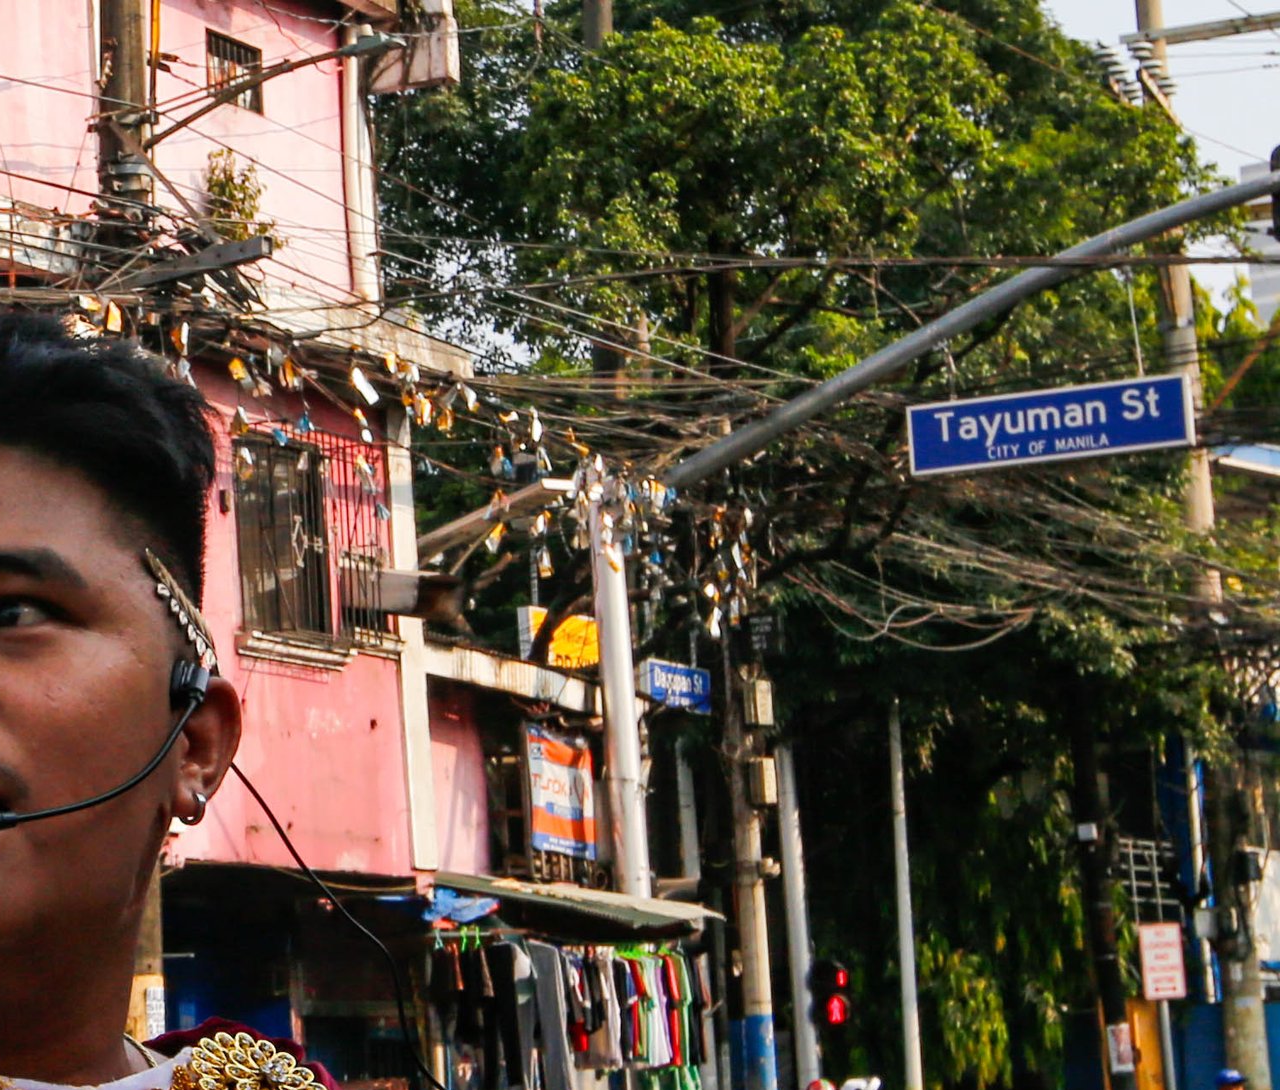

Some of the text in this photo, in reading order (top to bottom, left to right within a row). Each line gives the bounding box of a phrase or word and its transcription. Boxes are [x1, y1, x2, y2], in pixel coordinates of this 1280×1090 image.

[934, 387, 1160, 446] Tayuman St
[987, 434, 1109, 461] CITY OF MANILA
